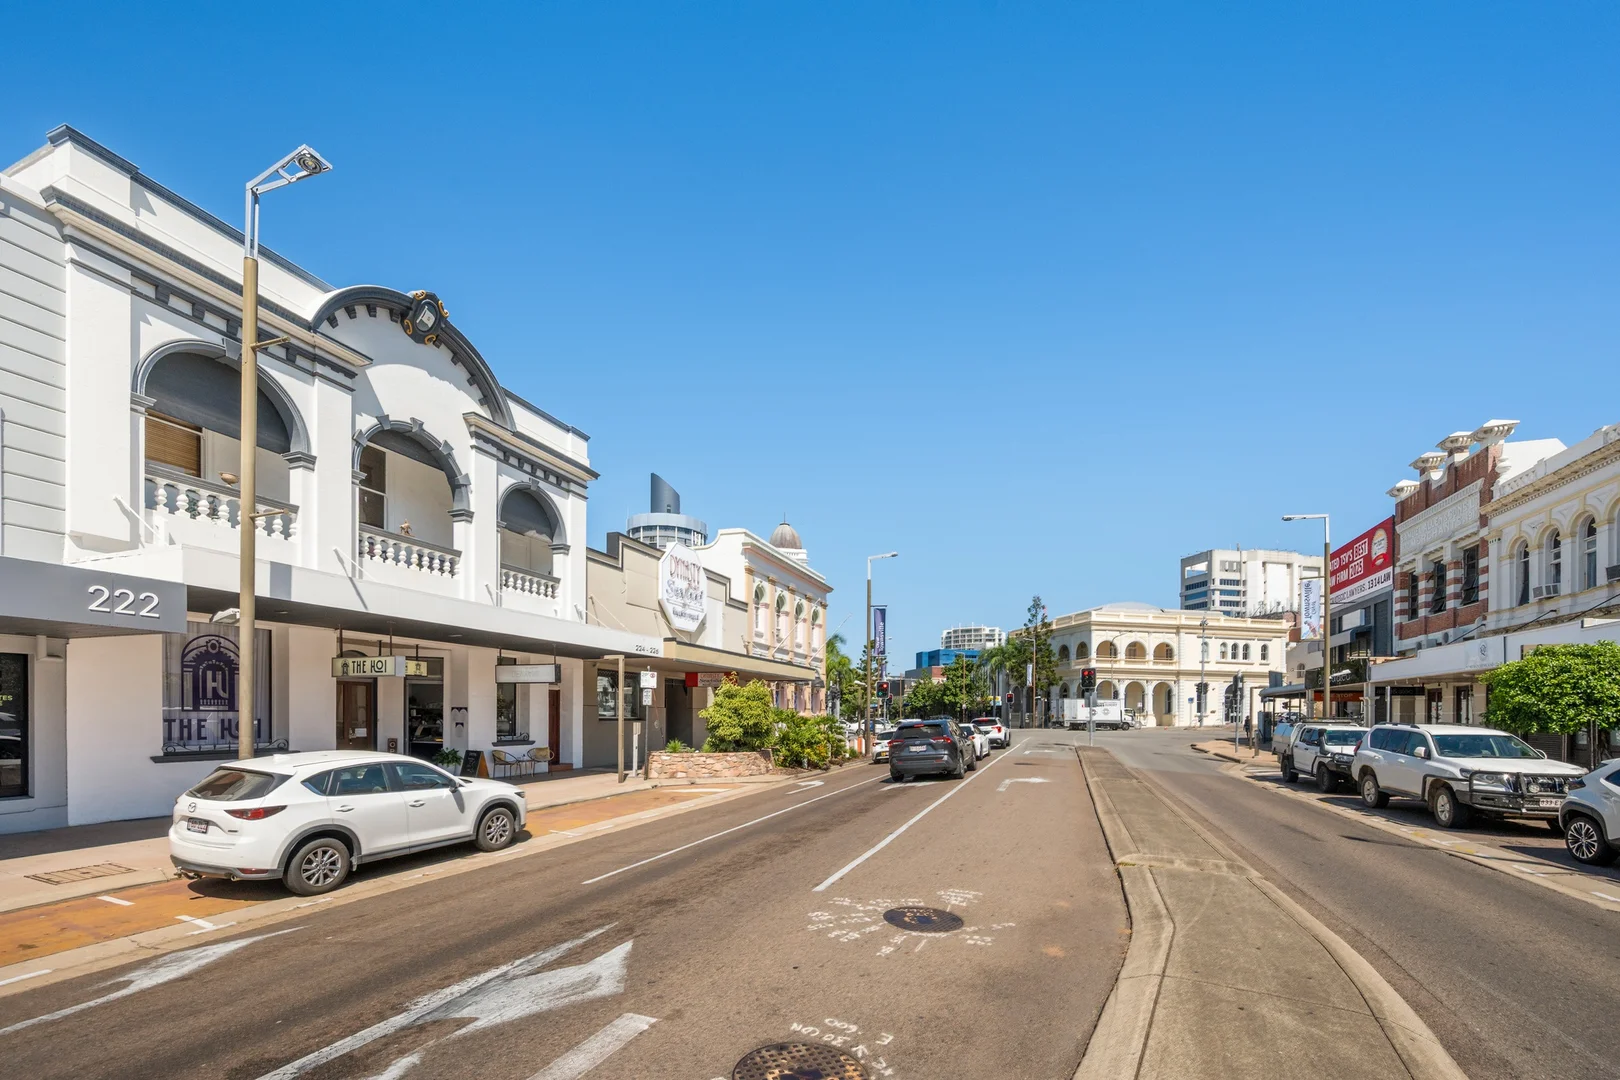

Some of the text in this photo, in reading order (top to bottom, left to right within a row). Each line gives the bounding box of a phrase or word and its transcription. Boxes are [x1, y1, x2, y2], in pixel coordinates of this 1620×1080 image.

[1354, 540, 1367, 559] BEST
[1350, 560, 1363, 578] 2025
[1380, 571, 1392, 585] LAW
[88, 585, 160, 618] 222
[351, 659, 387, 674] THE HOI
[163, 718, 262, 741] THE HI
